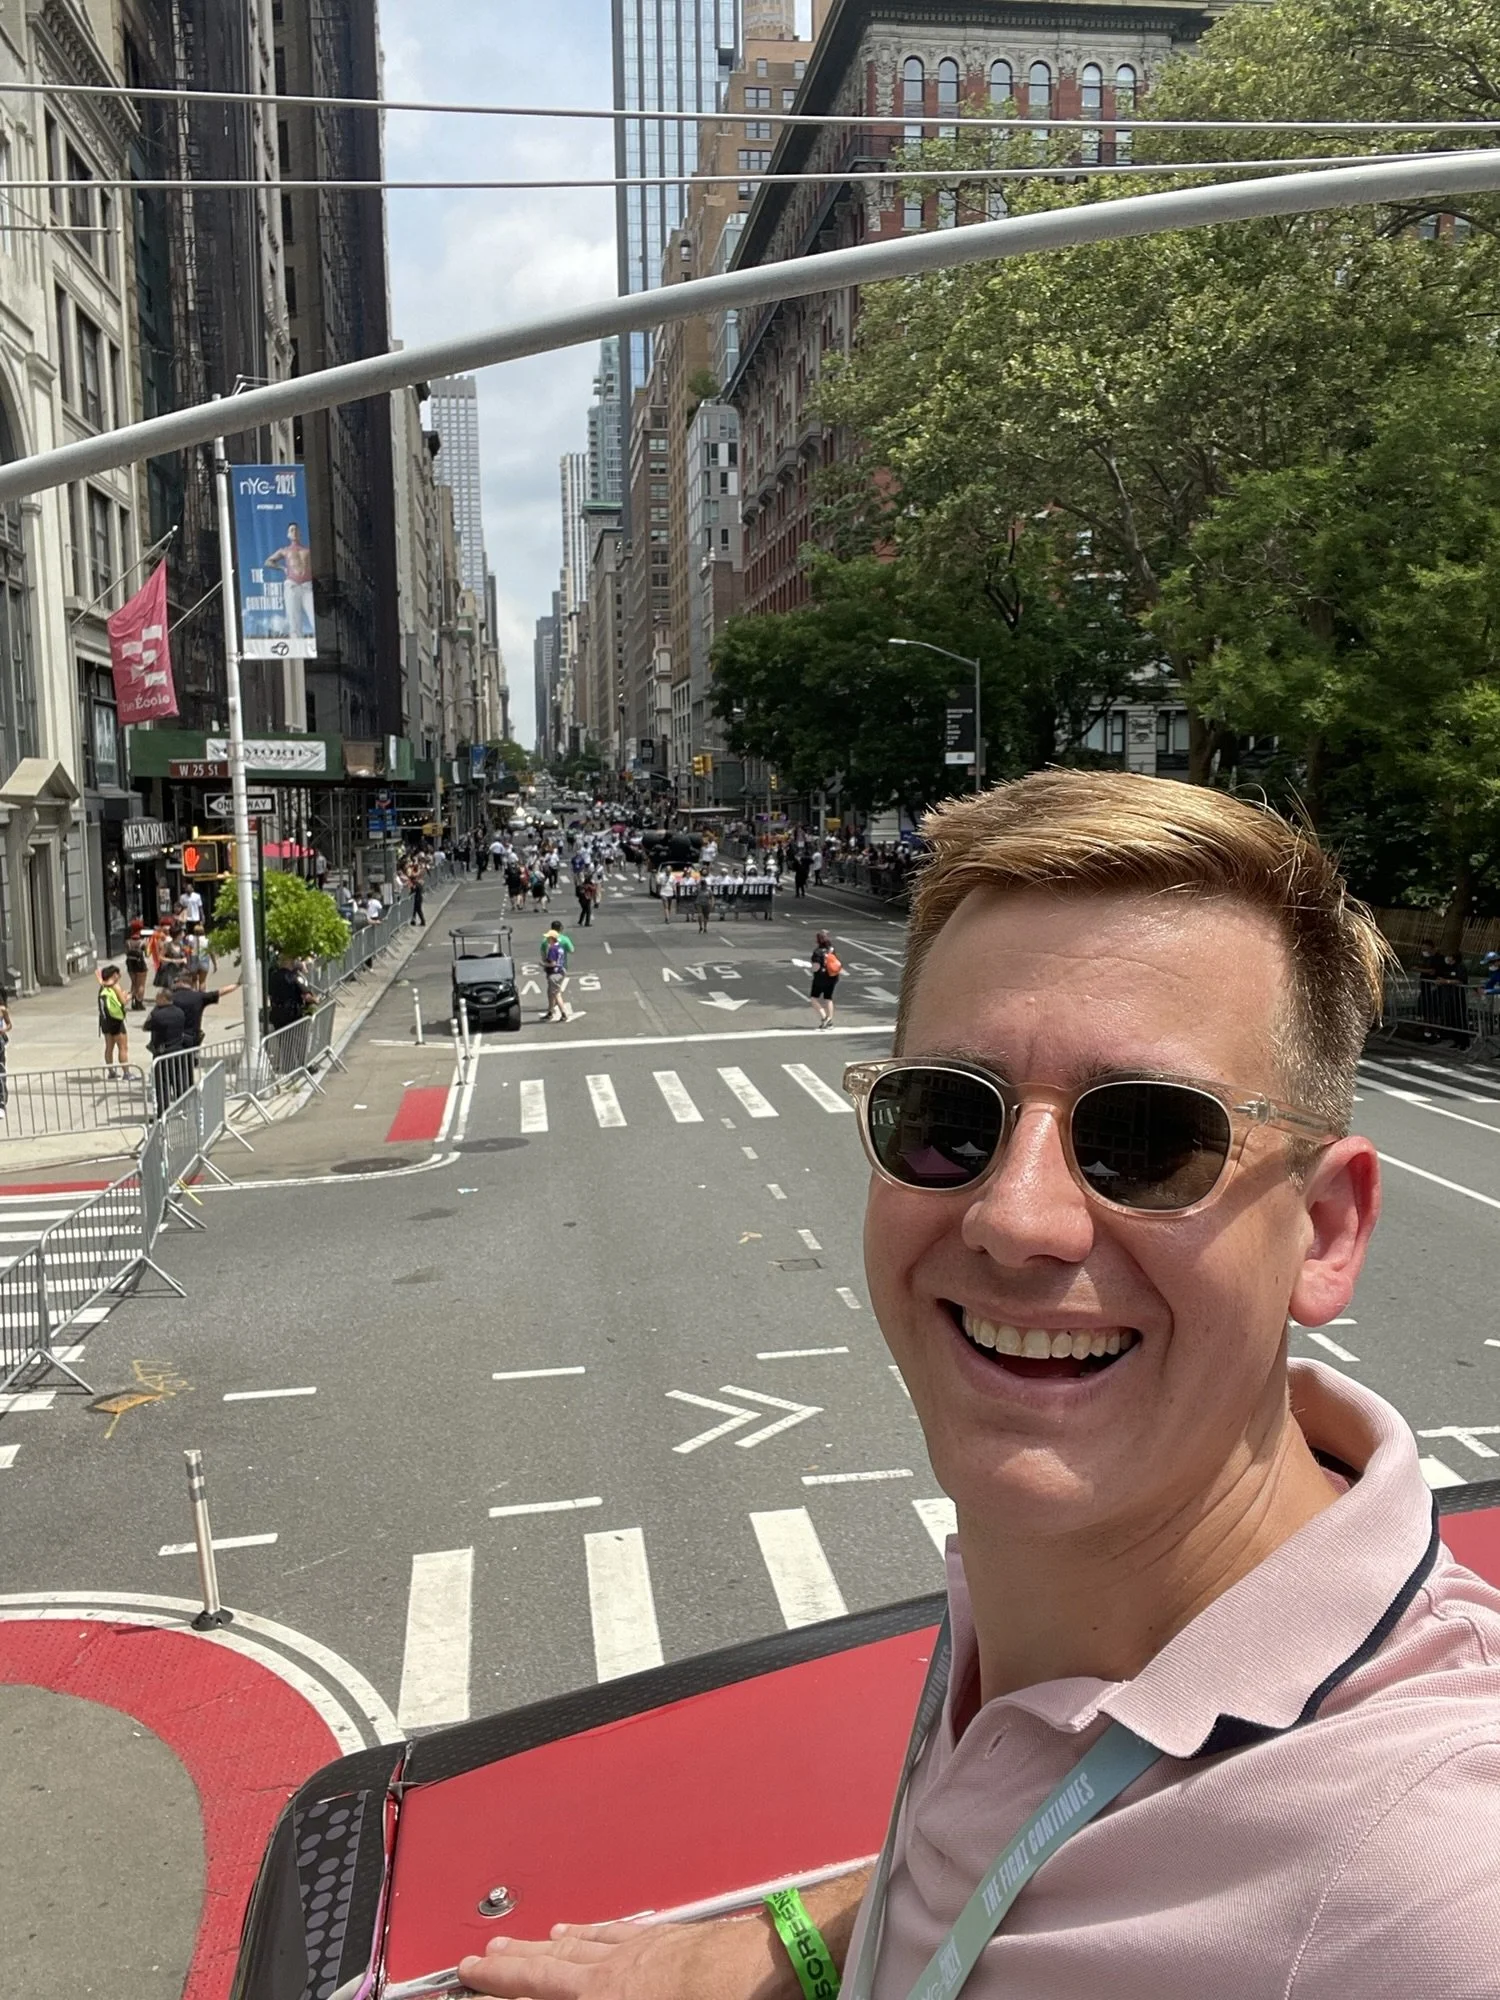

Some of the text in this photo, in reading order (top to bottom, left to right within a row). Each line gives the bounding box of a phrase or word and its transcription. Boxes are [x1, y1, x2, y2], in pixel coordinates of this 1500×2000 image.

[179, 763, 219, 777] W 25 St
[123, 823, 175, 848] MEMORIES
[980, 1771, 1096, 1917] THE FIGHT CONTINUES
